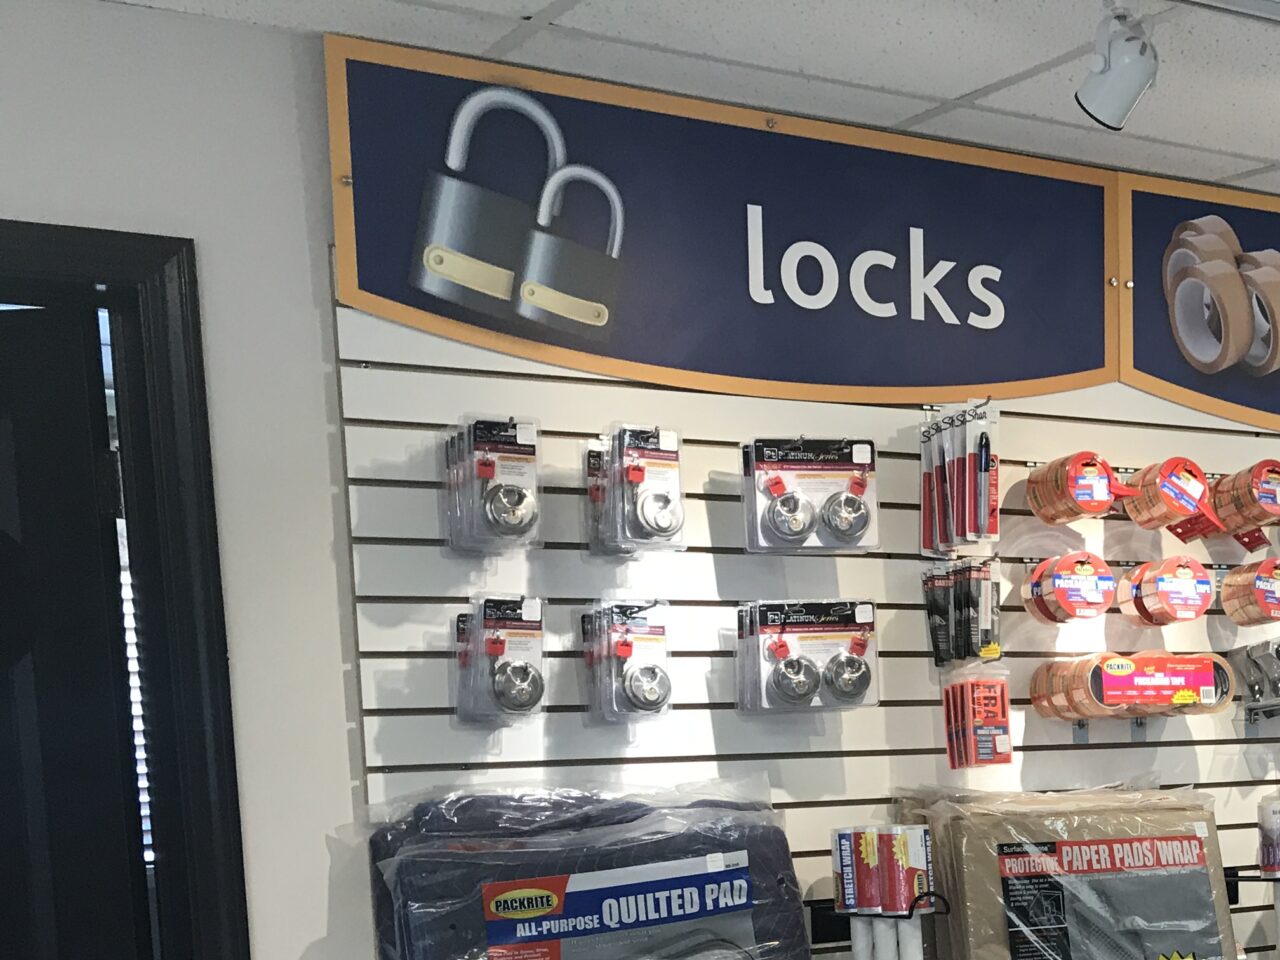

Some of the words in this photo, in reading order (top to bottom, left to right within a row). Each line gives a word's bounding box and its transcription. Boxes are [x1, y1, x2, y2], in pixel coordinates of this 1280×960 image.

[746, 203, 1006, 330] locks
[841, 838, 852, 866] WRAP
[1061, 844, 1110, 871] PAPER
[843, 866, 855, 905] STRETCH
[493, 893, 554, 915] PACKRITE
[515, 914, 600, 939] ALL-PURPOSE
[601, 886, 700, 929] QUILTED
[705, 878, 748, 911] PAD
